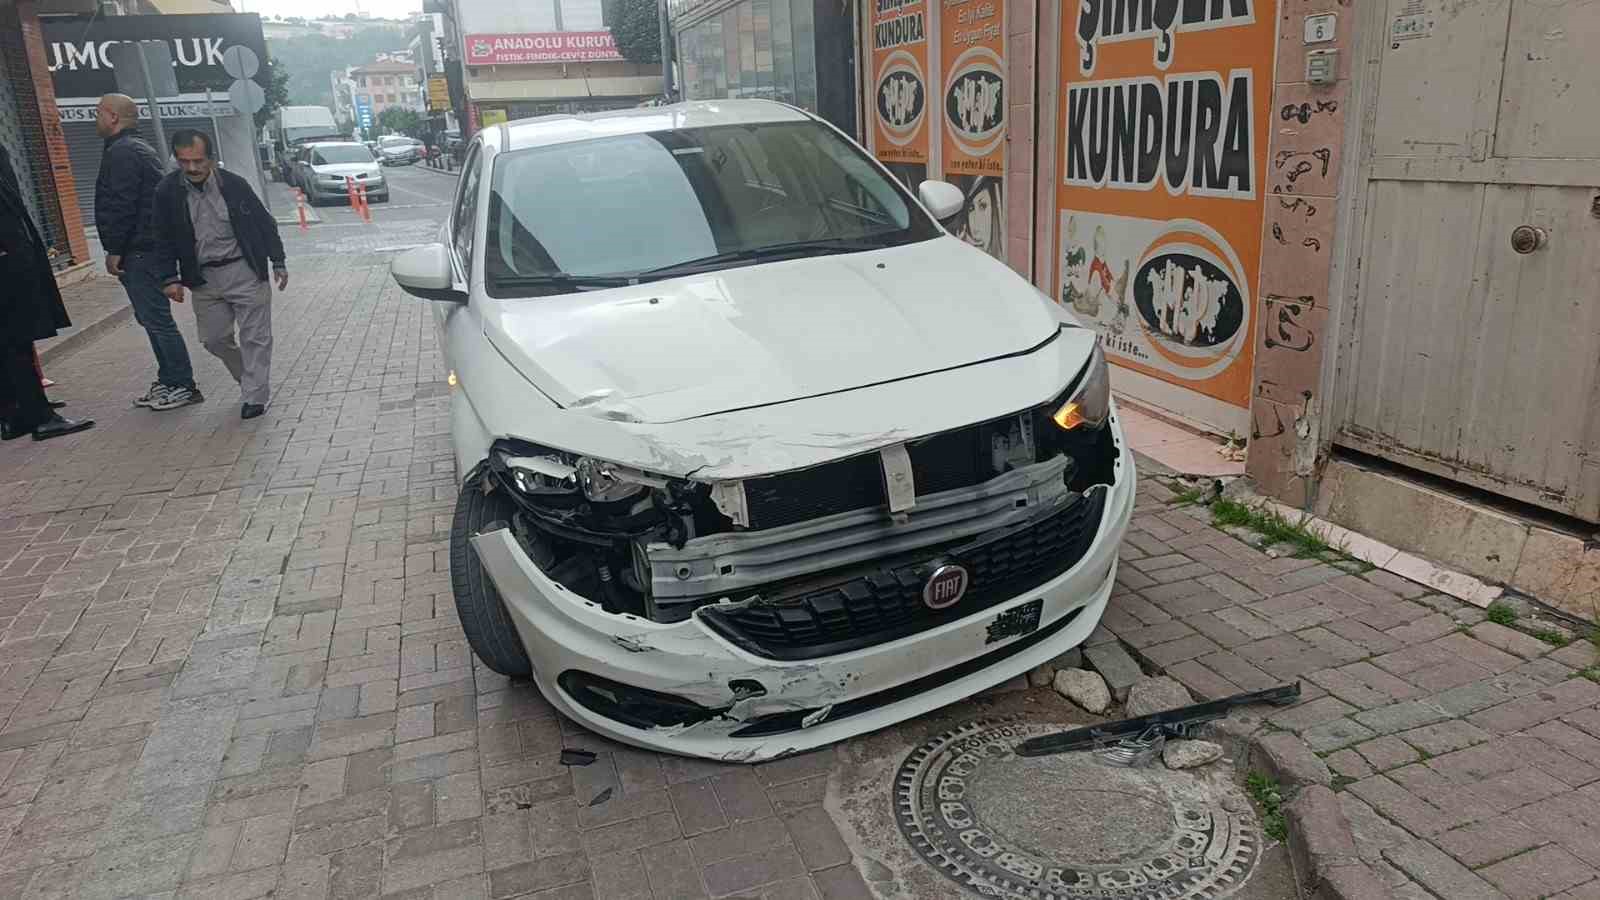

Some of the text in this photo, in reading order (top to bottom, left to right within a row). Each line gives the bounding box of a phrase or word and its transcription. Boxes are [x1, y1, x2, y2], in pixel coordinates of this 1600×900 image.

[494, 36, 562, 50] ANADOLU
[874, 13, 924, 49] KUNDURA
[1315, 25, 1324, 39] 6
[1066, 76, 1251, 192] KUNDURA
[935, 575, 961, 601] FIAT
